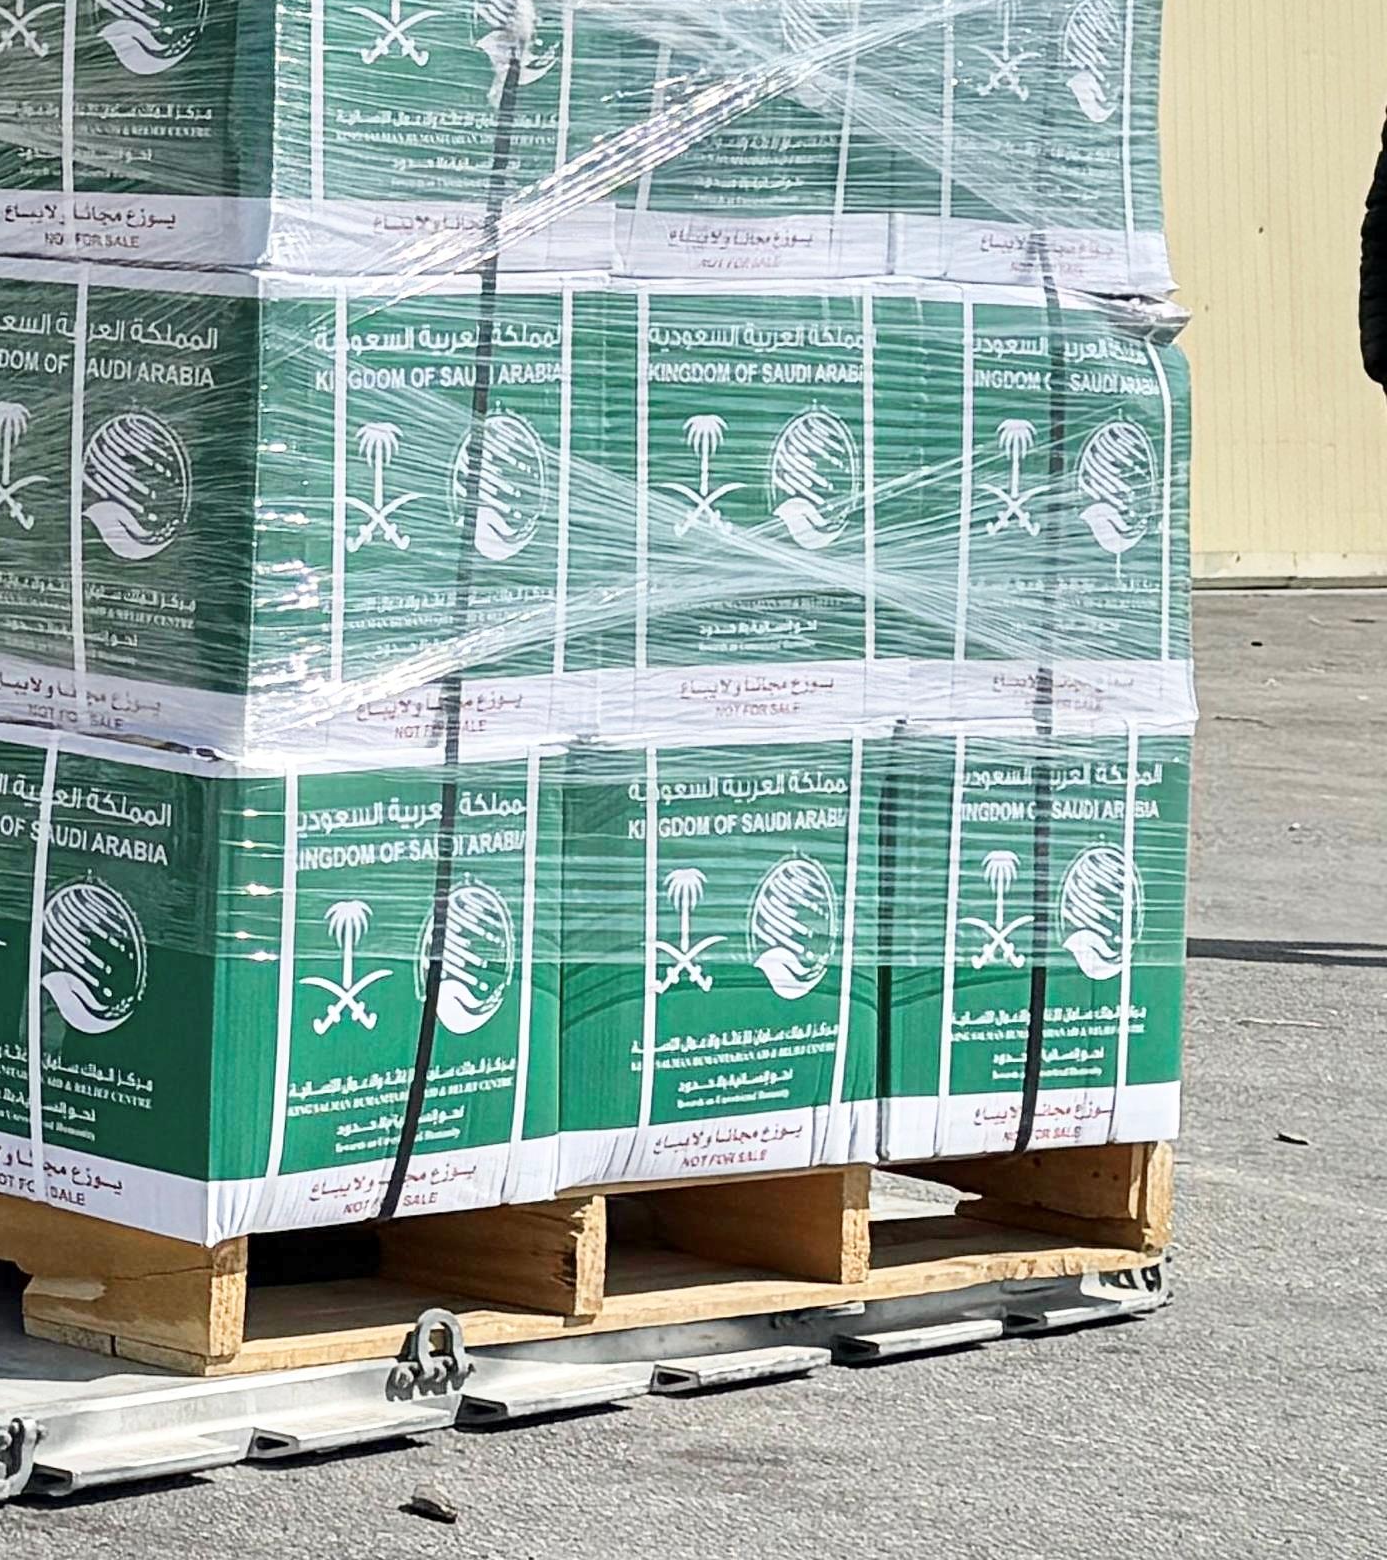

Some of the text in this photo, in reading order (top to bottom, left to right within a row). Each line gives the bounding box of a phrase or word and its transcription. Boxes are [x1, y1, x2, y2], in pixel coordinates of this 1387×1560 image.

[44, 231, 72, 247] NO
[104, 234, 140, 249] SALE
[130, 317, 219, 351] المملكة
[648, 322, 739, 353] السعودية
[743, 322, 805, 352] العربية
[43, 353, 71, 375] OF
[77, 355, 133, 382] AUDI
[138, 361, 215, 388] ARABIA
[315, 367, 406, 392] KIGDOM
[410, 367, 438, 389] OF
[440, 365, 495, 387] SAUI
[648, 362, 730, 383] KINGDOM
[735, 363, 758, 383] OF
[762, 363, 812, 384] SAUDI
[972, 369, 1041, 390] INGDOM
[1069, 371, 1118, 395] SAUDI
[89, 712, 125, 731] SALE
[395, 724, 422, 739] NOT
[722, 773, 785, 804] العربية
[87, 788, 173, 828] المملكة
[961, 799, 1160, 822] INGDOM SAUDI ARBIA
[627, 814, 711, 840] KIGDOM
[713, 813, 738, 836] OF
[740, 810, 792, 834] SAUDI
[0, 815, 27, 839] OF
[90, 831, 169, 866] ARABIA
[294, 843, 376, 872] INGDOM
[379, 840, 408, 864] OF
[681, 1153, 708, 1169] NOT
[737, 1148, 769, 1165] SALE
[50, 1184, 87, 1207] SALE
[70, 1166, 124, 1197] يوزع
[343, 1191, 439, 1215] NOT SALE
